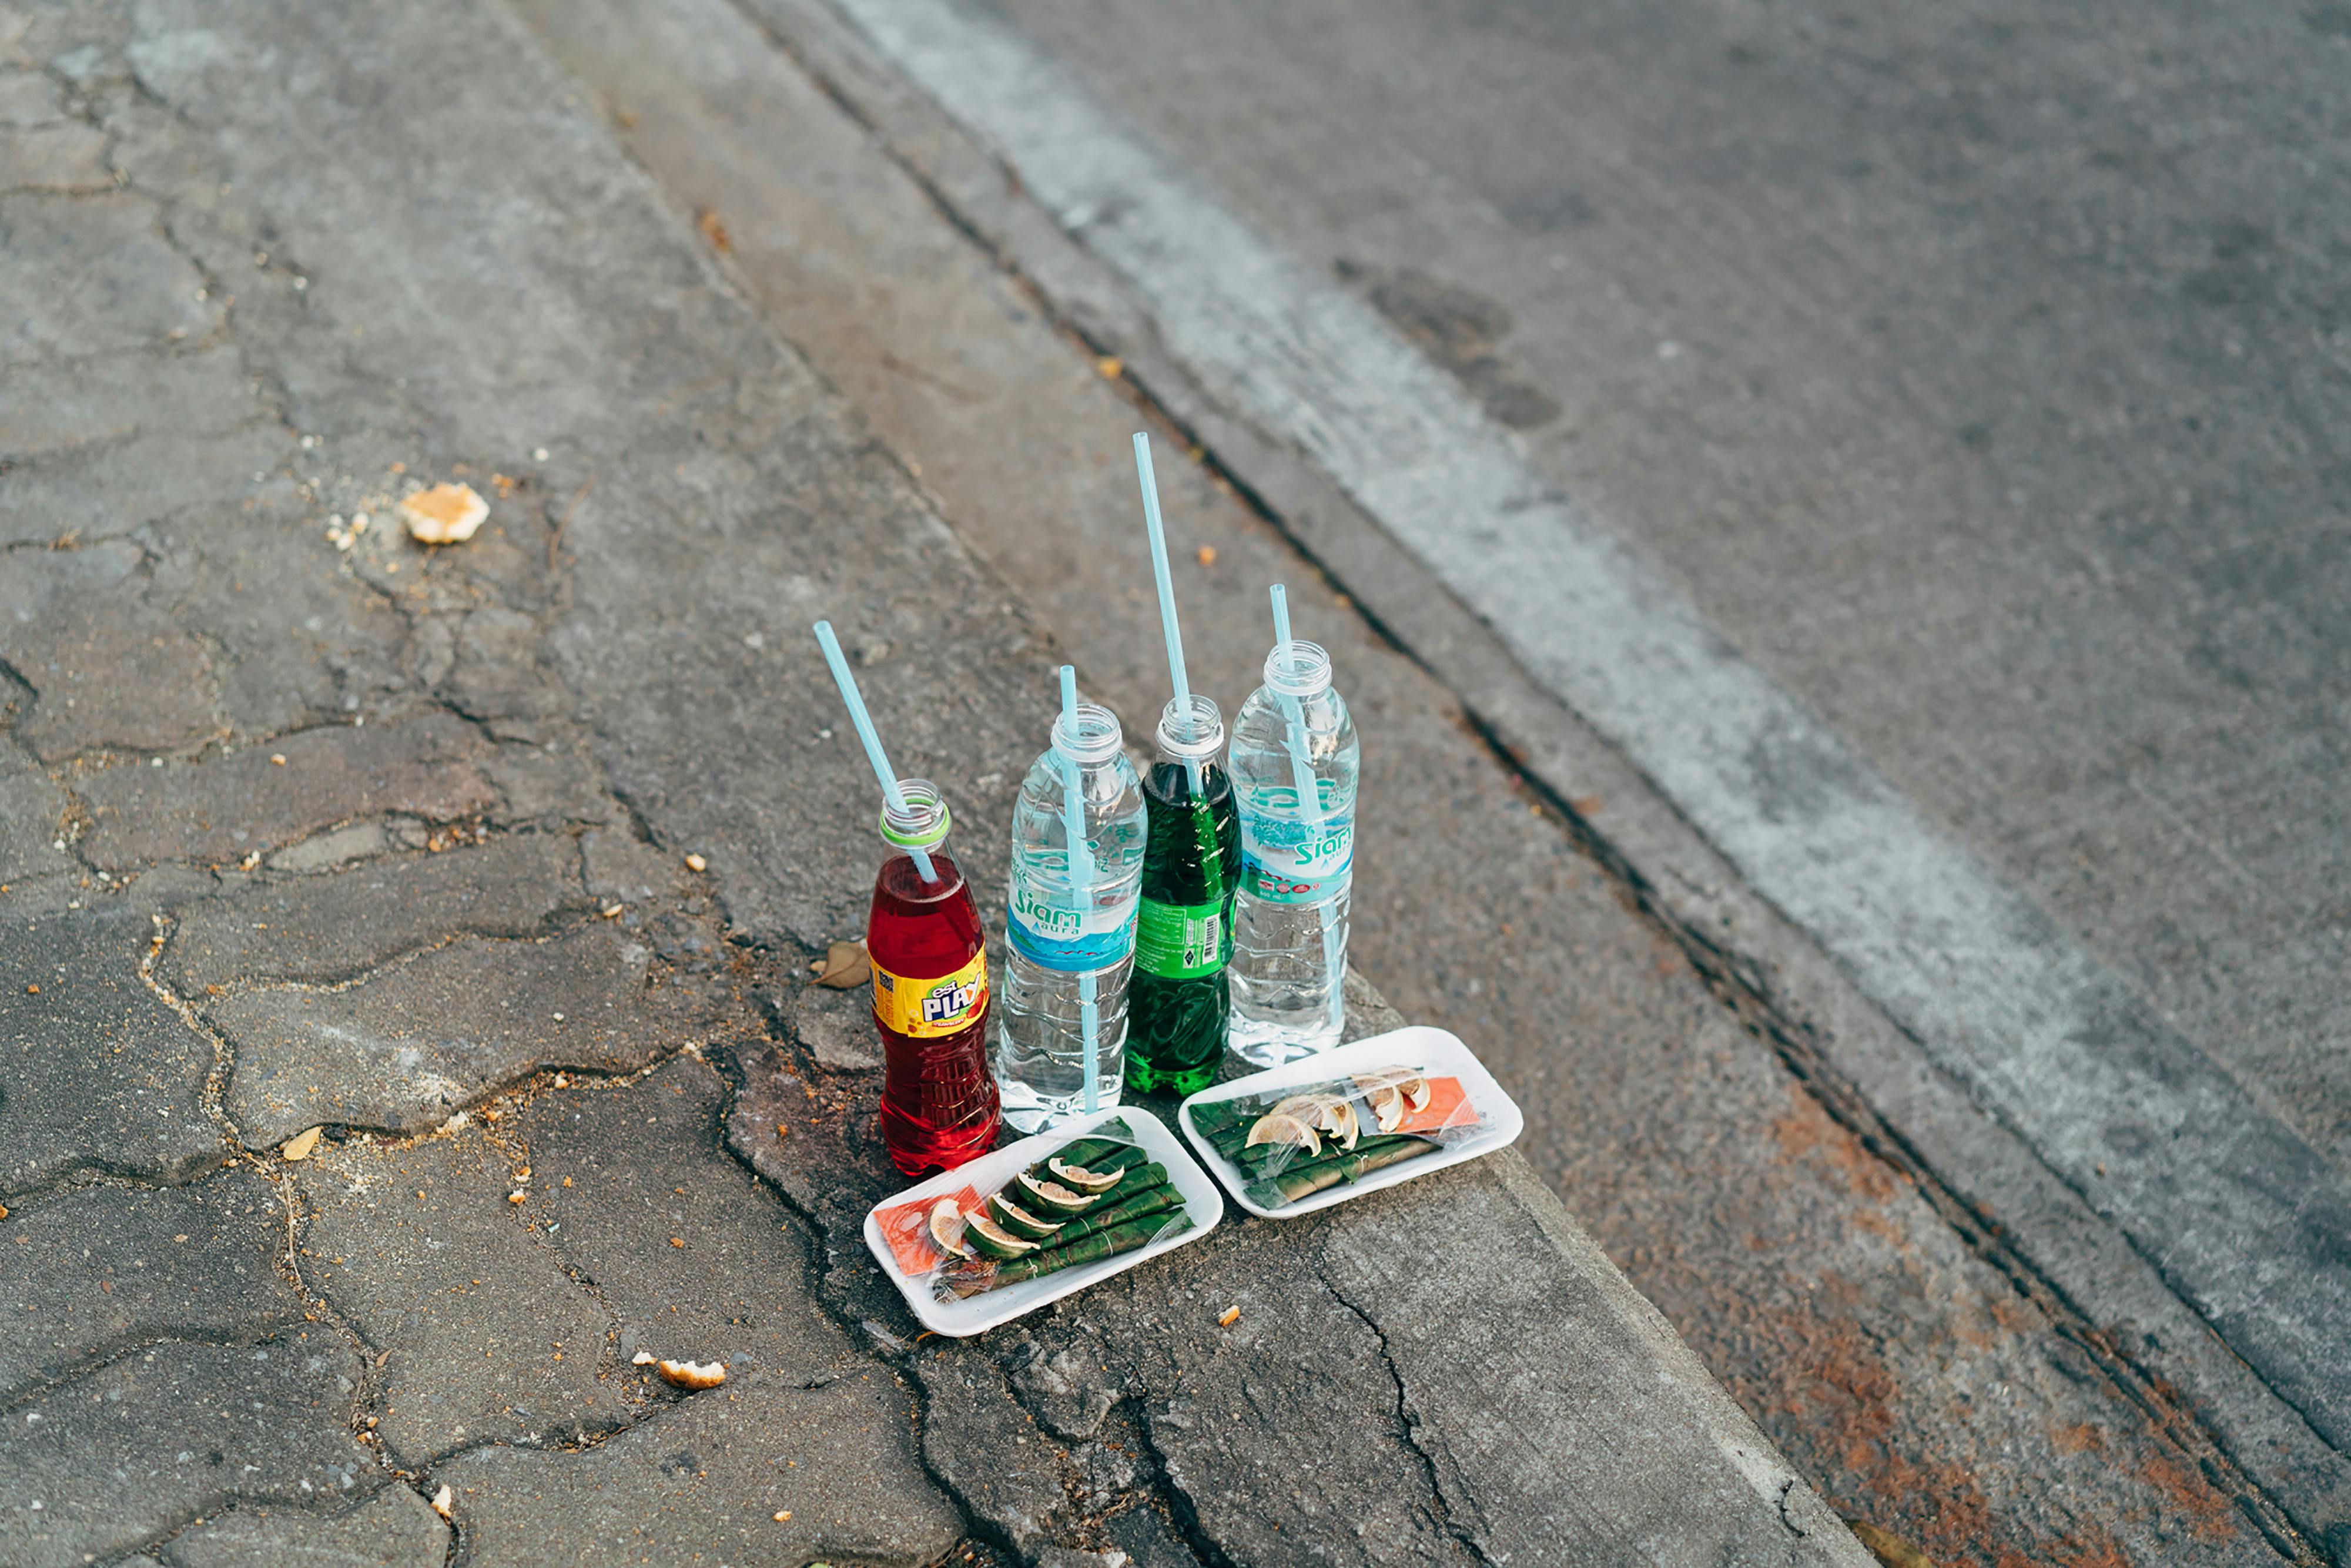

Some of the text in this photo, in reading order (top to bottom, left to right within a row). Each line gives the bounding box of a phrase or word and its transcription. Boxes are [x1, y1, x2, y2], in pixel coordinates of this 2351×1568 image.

[1014, 888, 1081, 928] Siam
[1041, 922, 1079, 935] aura
[922, 971, 981, 1022] PLAY
[932, 980, 957, 998] est
